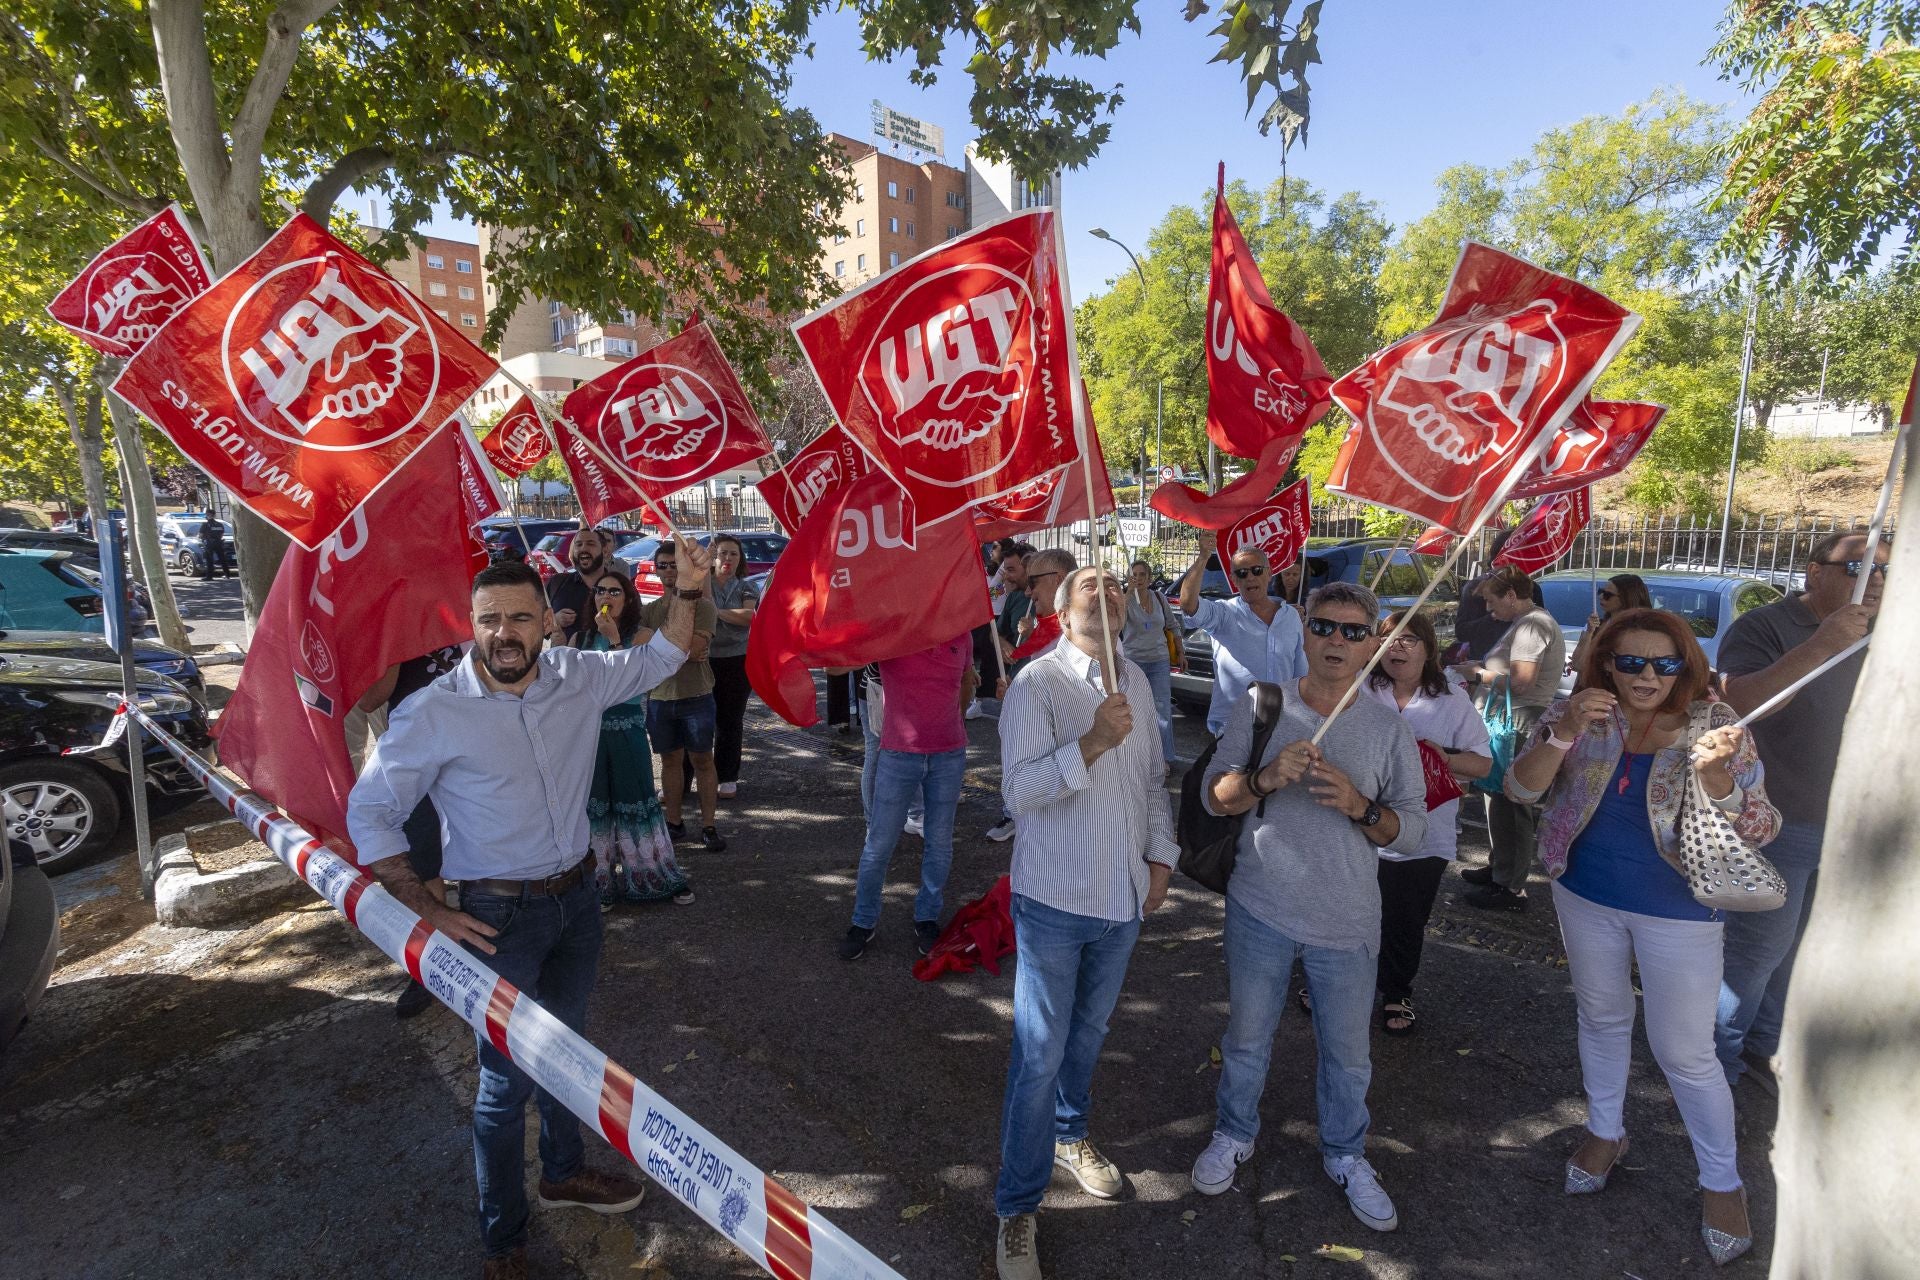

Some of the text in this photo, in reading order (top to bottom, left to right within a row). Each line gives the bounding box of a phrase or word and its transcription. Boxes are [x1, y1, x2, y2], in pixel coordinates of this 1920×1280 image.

[889, 110, 920, 129] Hospital
[890, 121, 905, 133] San
[905, 126, 927, 141] Pedro
[890, 131, 937, 154] de Alcántara
[93, 261, 165, 332] UGT
[240, 266, 381, 404] UGT
[880, 287, 1017, 415] UGT
[1402, 322, 1554, 419] UGT
[161, 378, 315, 508] www.ugt.es
[503, 416, 539, 455] UGT
[1122, 522, 1146, 532] SOLO
[1236, 511, 1284, 551] UGT
[641, 1106, 733, 1195] LINEA DE POLICIA
[647, 1147, 702, 1209] NO PASAR
